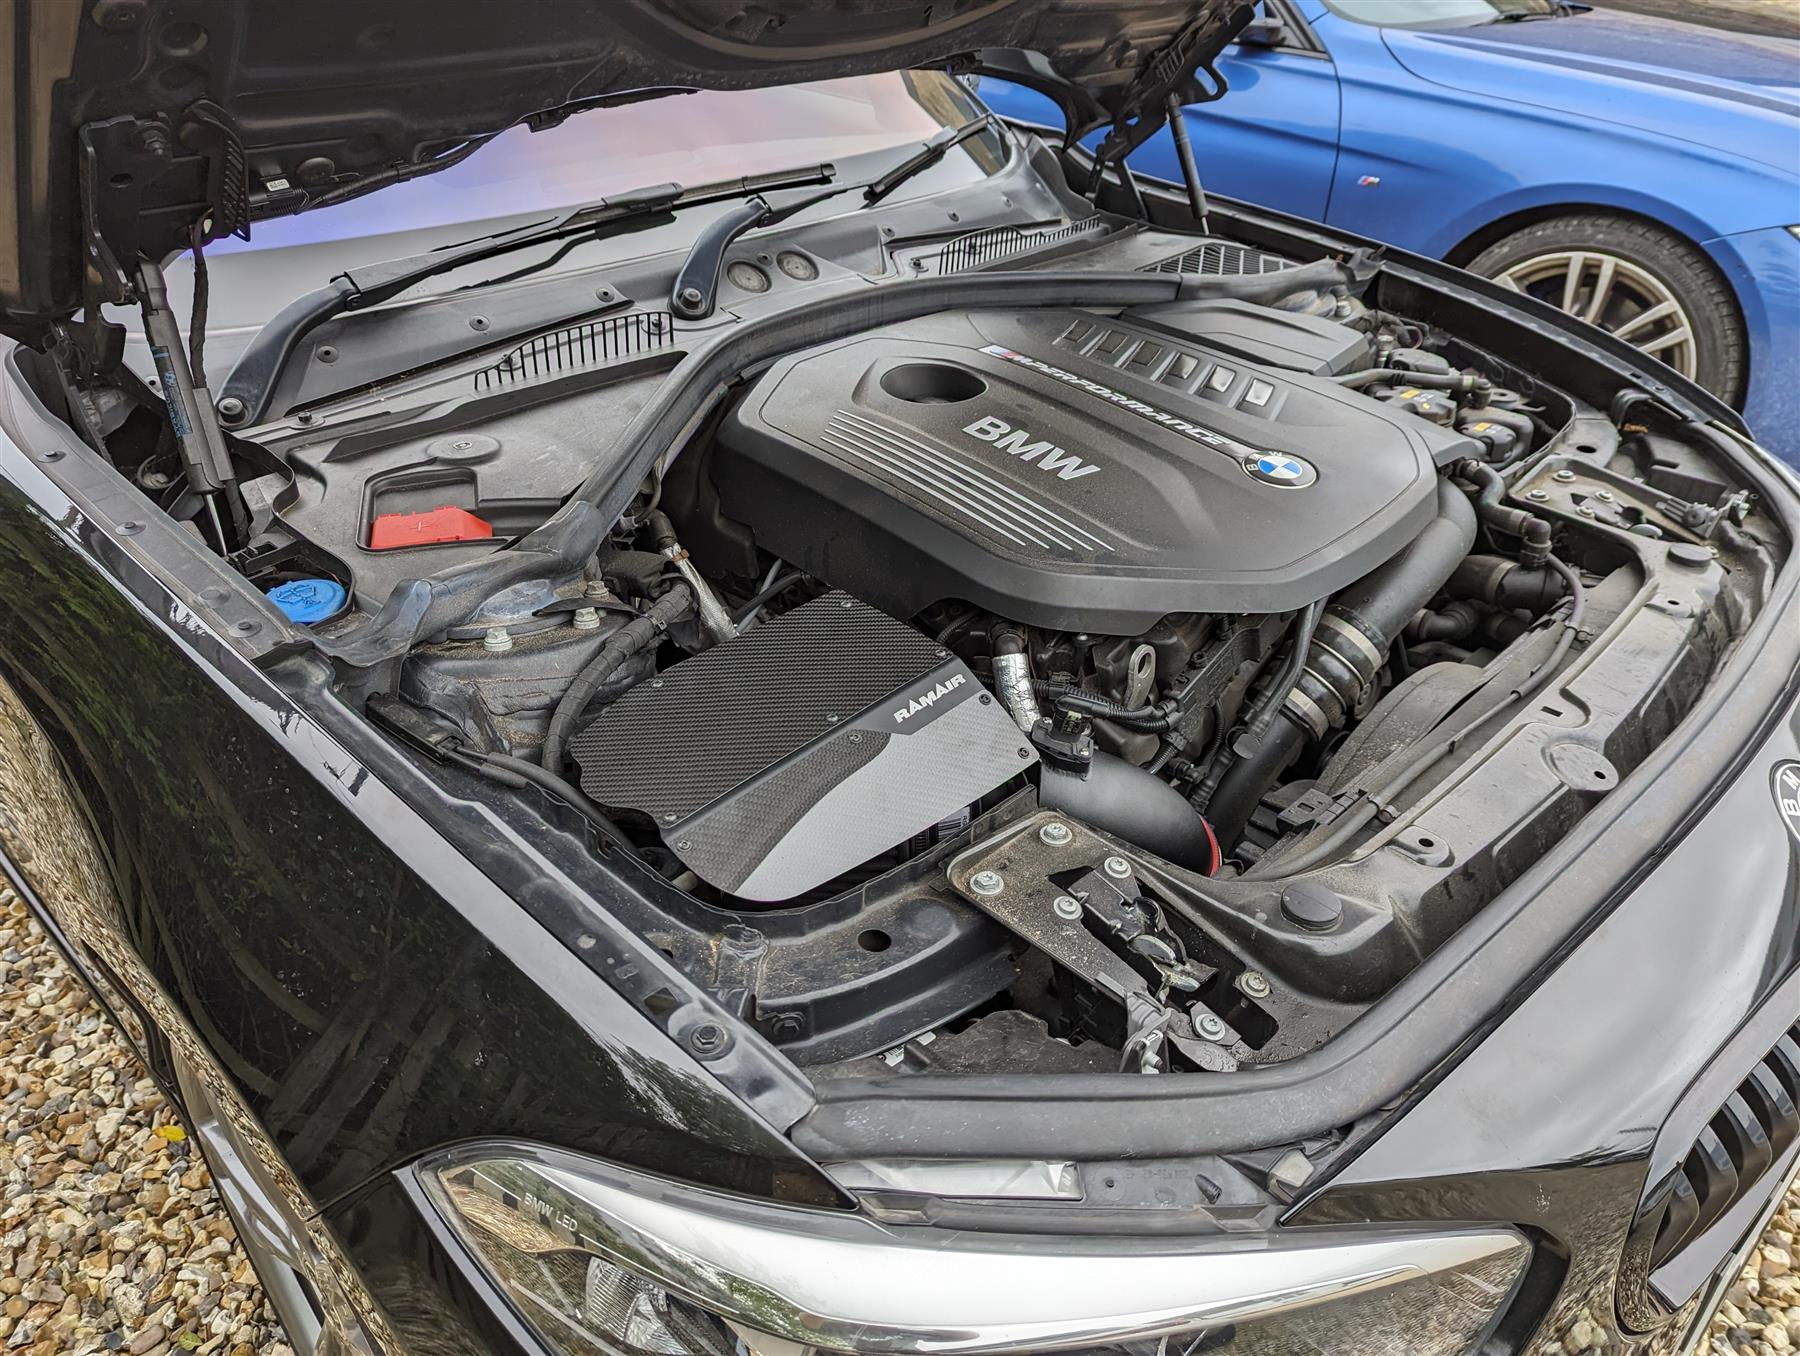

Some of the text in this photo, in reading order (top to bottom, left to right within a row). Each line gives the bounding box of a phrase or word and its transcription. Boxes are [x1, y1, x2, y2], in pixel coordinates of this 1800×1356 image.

[962, 415, 1101, 481] BMW
[893, 673, 967, 724] RAMAIR
[524, 1192, 578, 1231] BMW LED
